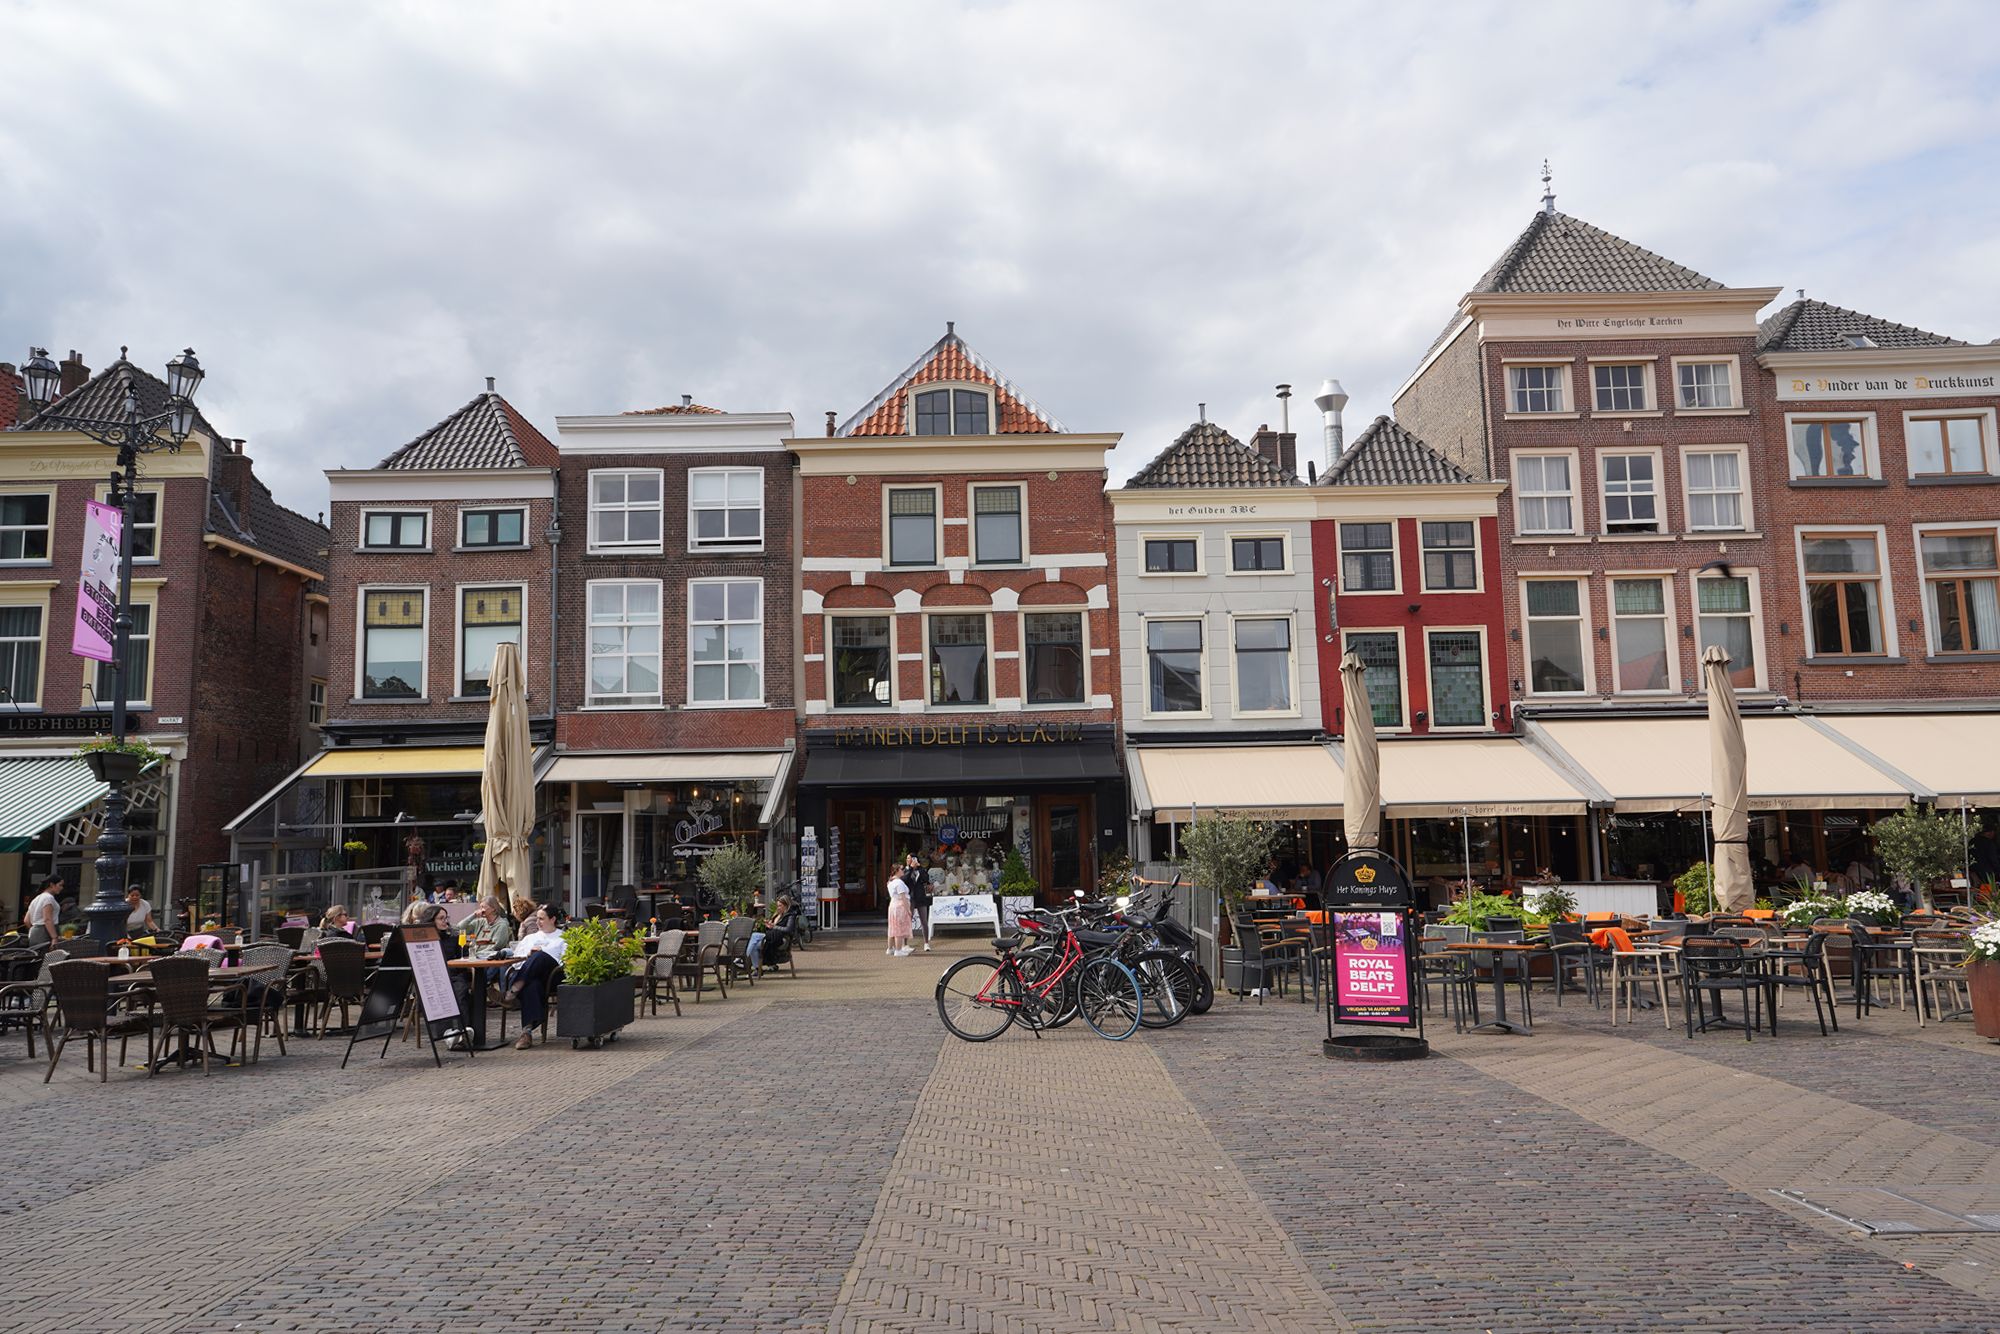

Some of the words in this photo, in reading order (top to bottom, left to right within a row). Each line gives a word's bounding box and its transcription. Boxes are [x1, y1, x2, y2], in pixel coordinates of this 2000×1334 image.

[1792, 379, 1811, 392] De
[1865, 379, 1889, 390] van
[1894, 378, 1908, 389] de
[1230, 505, 1256, 513] ABC
[8, 717, 112, 731] LIEFHEBBE
[920, 723, 999, 745] DELFTS
[960, 830, 992, 839] OUTLET
[425, 861, 463, 872] Michiel
[465, 861, 479, 871] de
[1336, 886, 1349, 894] Het
[1378, 885, 1398, 896] Huys
[1349, 959, 1393, 969] ROYAL
[1350, 970, 1394, 981] BEATS
[1350, 982, 1395, 993] DELFT
